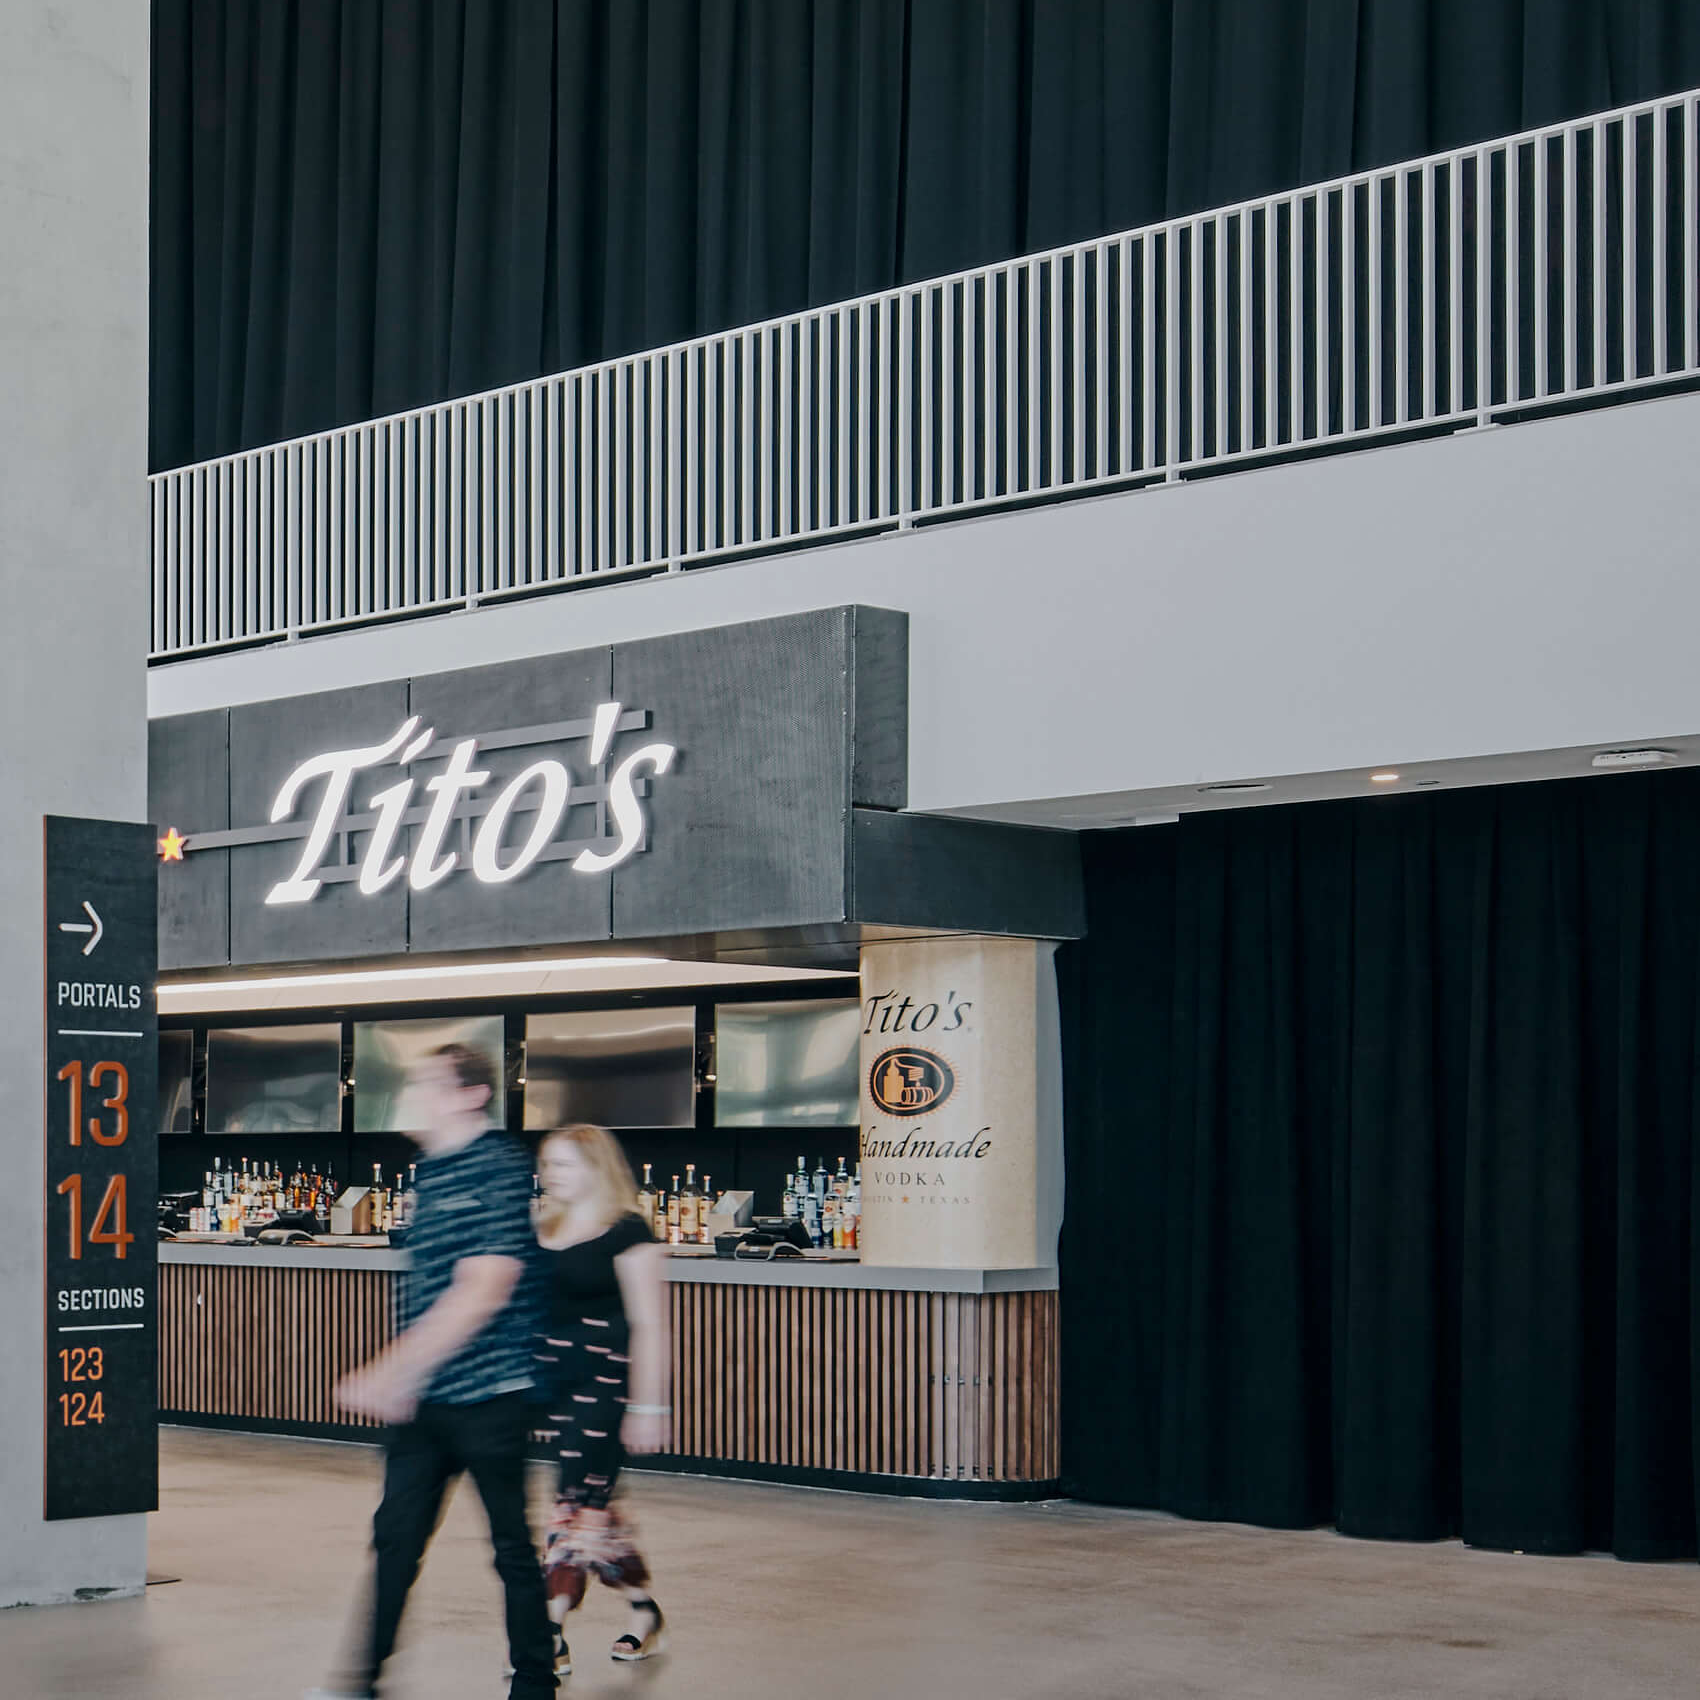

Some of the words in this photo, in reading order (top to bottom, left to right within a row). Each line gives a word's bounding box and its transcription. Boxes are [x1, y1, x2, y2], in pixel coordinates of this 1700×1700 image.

[264, 701, 677, 905] Tito's
[57, 981, 141, 1009] PORTALS
[863, 989, 973, 1035] Tito's
[57, 1059, 130, 1147] 13
[873, 1171, 946, 1186] VODKA
[57, 1173, 135, 1260] 14
[58, 1287, 145, 1312] SECTIONS
[58, 1346, 104, 1382] 123
[58, 1391, 105, 1427] 124
